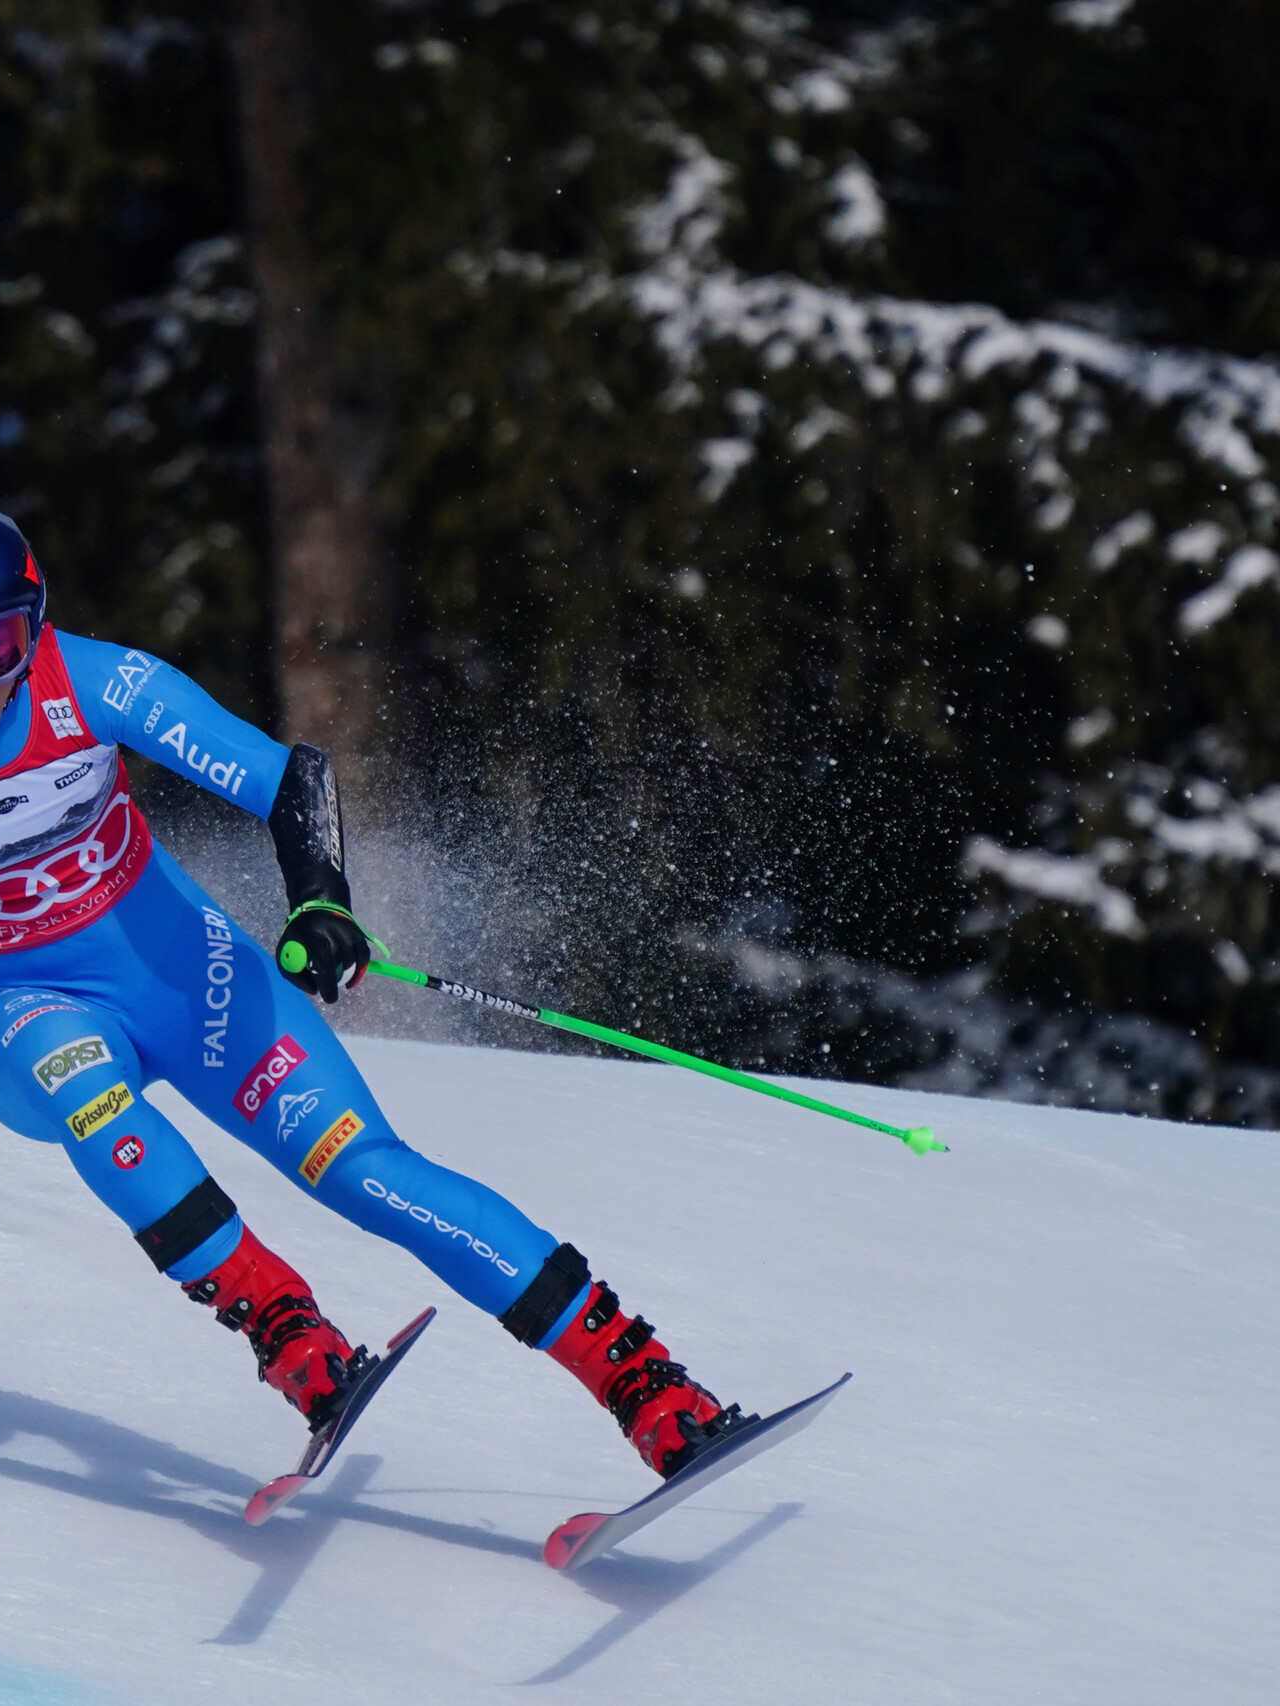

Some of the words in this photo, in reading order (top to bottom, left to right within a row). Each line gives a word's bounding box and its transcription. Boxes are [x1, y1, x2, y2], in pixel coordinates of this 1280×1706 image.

[102, 650, 151, 711] EA7
[158, 722, 247, 795] Audi
[35, 912, 67, 931] Ski
[71, 869, 127, 916] World
[202, 905, 235, 1068] FALCONERI
[440, 980, 540, 1019] KOMPERDELL
[35, 1040, 106, 1089] FORST
[243, 1045, 298, 1111] enel
[116, 1140, 137, 1159] RTL
[282, 1096, 320, 1142] AVIO
[304, 1117, 357, 1181] PIRELLI
[362, 1178, 519, 1277] PIQUADRO
